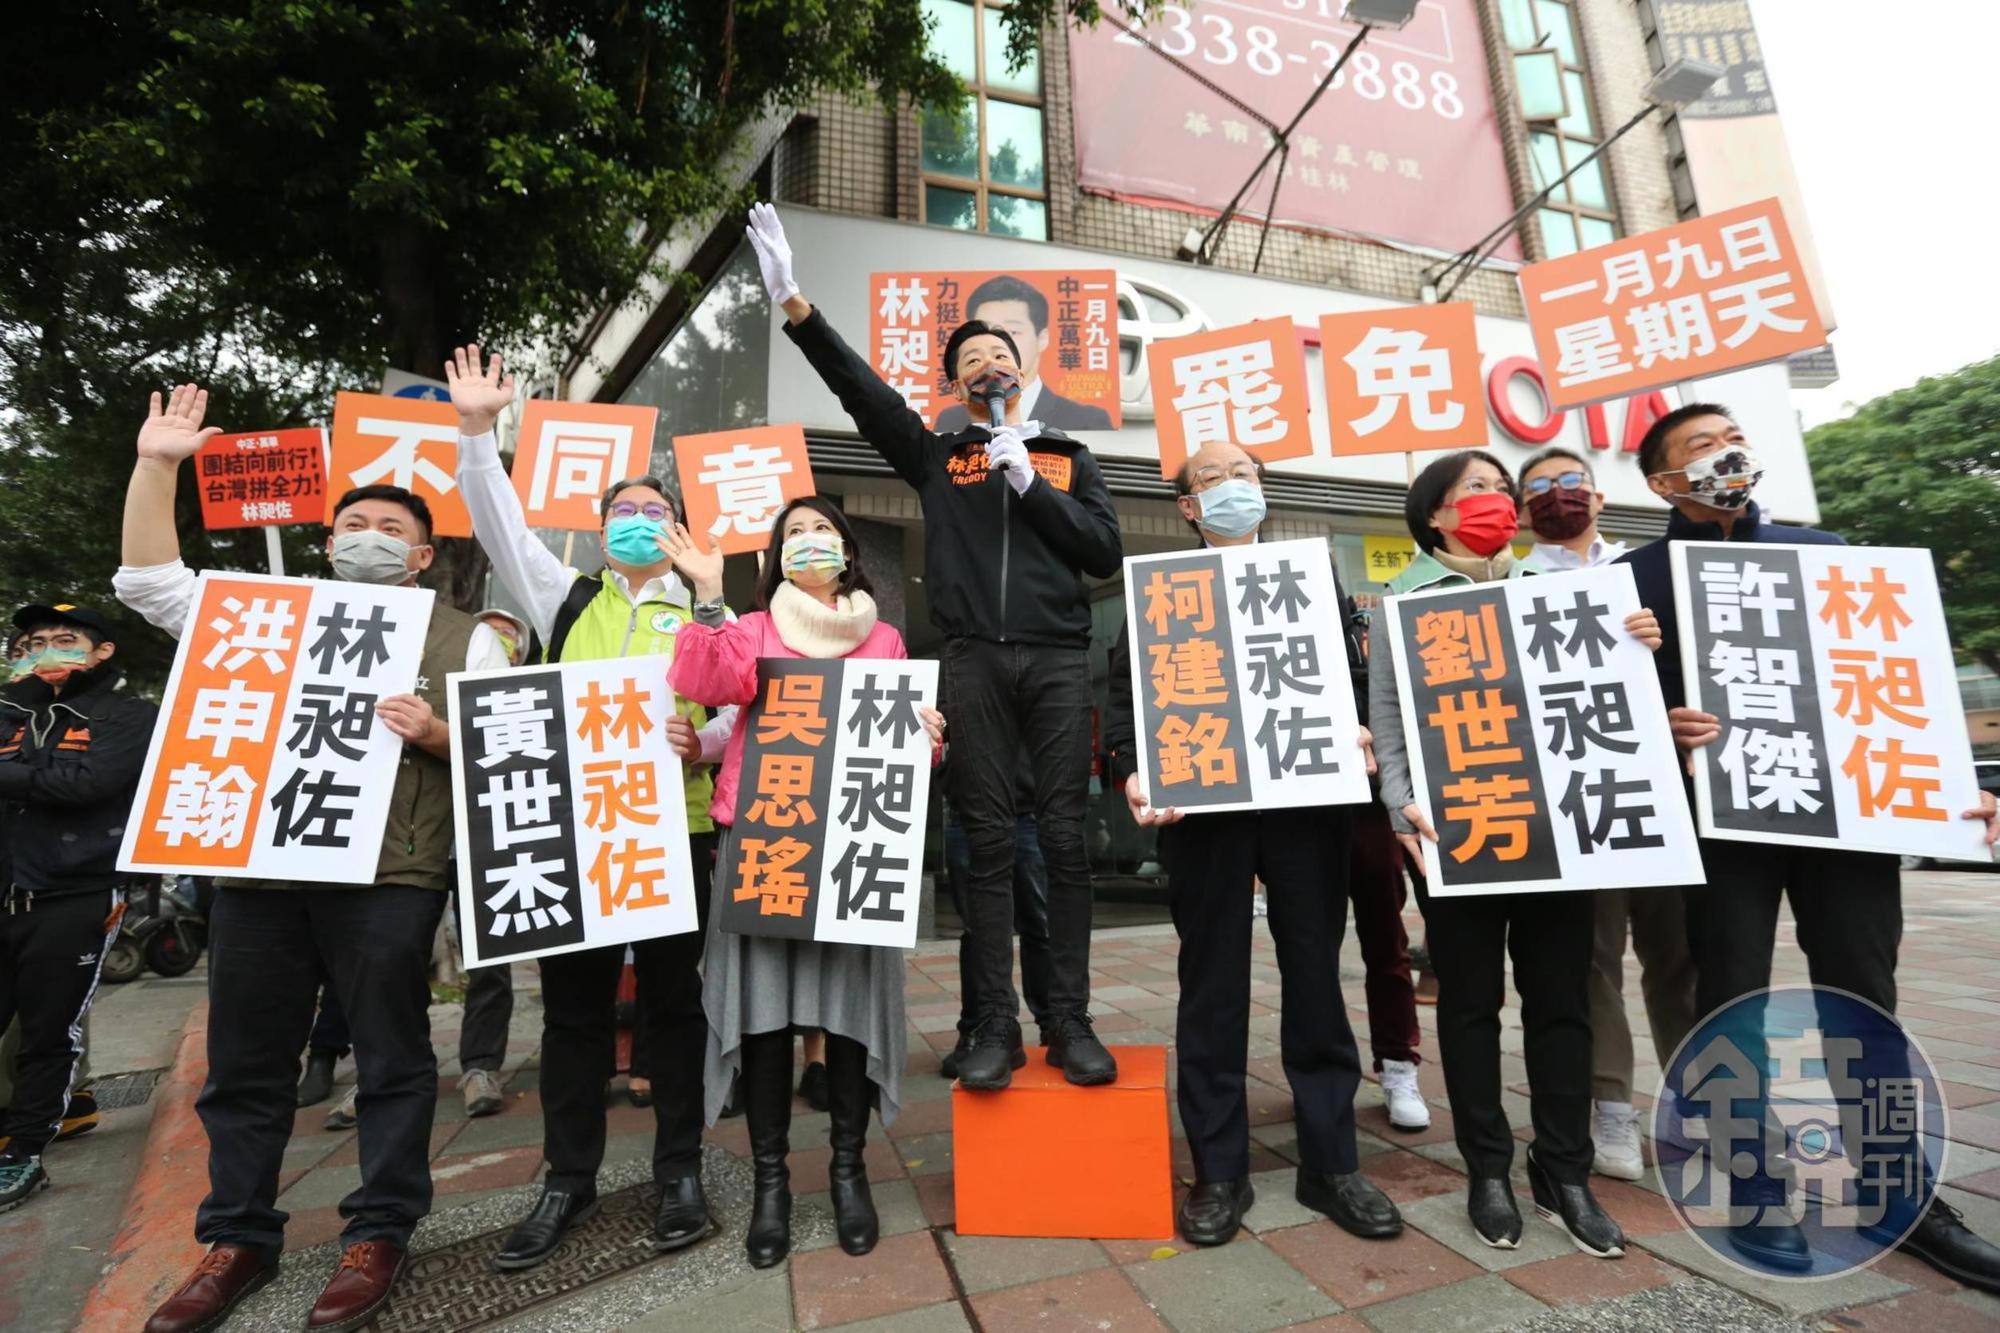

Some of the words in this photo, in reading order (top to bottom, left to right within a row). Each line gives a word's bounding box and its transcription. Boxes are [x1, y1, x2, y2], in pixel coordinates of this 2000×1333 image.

[1057, 276, 1081, 371] 中正萬華
[1083, 283, 1110, 371] 一月九日
[1541, 216, 1782, 306] 一月九日
[1554, 272, 1806, 389] 星期天
[349, 417, 458, 496] 不
[527, 420, 633, 512] 同
[698, 443, 793, 539] 意
[952, 472, 987, 485] FREDDY
[1172, 340, 1290, 446] 罷
[1344, 326, 1465, 438] 免
[241, 501, 293, 521] 林昶佐
[155, 595, 296, 850] 洪申翰
[270, 602, 397, 849] 林昶佐
[1143, 567, 1237, 788] 柯建銘
[1236, 559, 1339, 782] 林昶佐
[1413, 602, 1536, 864] 劉世芳
[1523, 589, 1665, 855] 林昶佐
[1699, 561, 1822, 815] 許智傑
[1815, 564, 1950, 822] 林昶佐
[472, 687, 572, 937] 黃世杰
[576, 678, 670, 917] 林昶佐
[732, 674, 828, 918] 吳思瑤
[829, 673, 923, 923] 林昶佐
